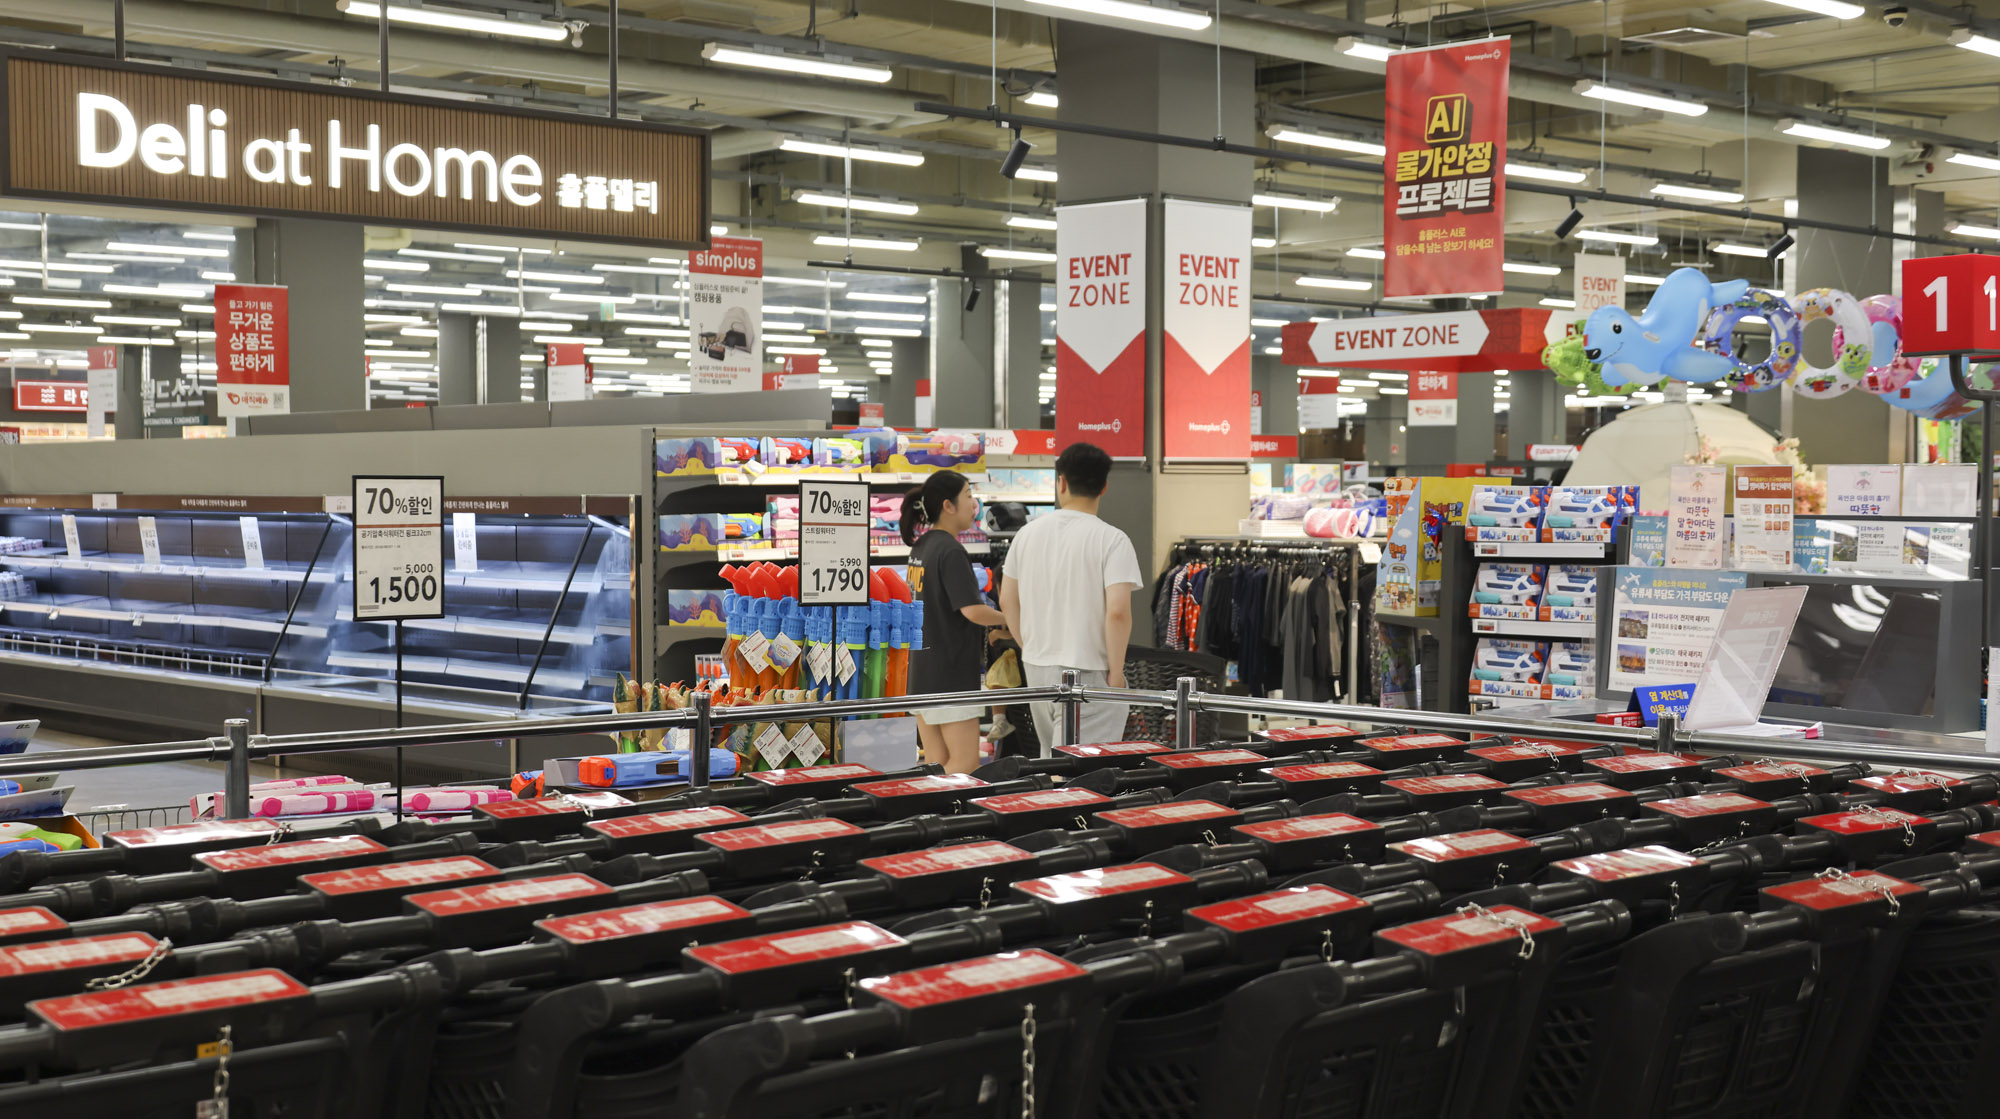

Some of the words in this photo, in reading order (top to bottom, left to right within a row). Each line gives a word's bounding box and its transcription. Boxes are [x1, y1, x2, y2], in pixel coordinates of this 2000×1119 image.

[1465, 53, 1492, 61] Homeplus
[1428, 99, 1461, 134] AI
[78, 92, 228, 178] Deli
[243, 129, 311, 186] at
[328, 119, 543, 206] Home
[1395, 141, 1493, 182] 물가안정
[1396, 177, 1492, 215] 프로젝트
[1419, 229, 1448, 241] 홈플러스
[1427, 242, 1441, 254] 남는
[1443, 240, 1467, 252] 장보기
[1468, 238, 1494, 250] 하세요!
[696, 250, 756, 272] simplus
[1069, 253, 1132, 279] EVENT
[1179, 253, 1240, 279] EVENT
[1582, 276, 1618, 293] EVENT
[1068, 282, 1130, 308] ZONE
[1179, 282, 1239, 308] ZONE
[1582, 293, 1617, 309] ZONE
[1983, 275, 1997, 331] 1
[245, 301, 258, 310] 가기
[1922, 276, 1948, 332] 1
[229, 312, 274, 331] 무거운
[229, 332, 275, 351] 상품도
[1335, 328, 1397, 351] EVENT
[1402, 324, 1459, 347] ZONE
[103, 349, 114, 368] 12
[229, 353, 275, 373] 편하게
[550, 347, 558, 366] 3
[785, 357, 793, 373] 4
[1301, 379, 1310, 394] 7
[1418, 375, 1448, 391] 편하게
[1252, 393, 1259, 406] 8
[1078, 421, 1111, 432] Homeplus
[1188, 422, 1221, 433] Homeplus
[985, 436, 1004, 447] ONE
[365, 487, 432, 515] 70%할인
[809, 490, 862, 516] 70%할인
[1850, 504, 1880, 514] 따뜻한
[1686, 506, 1710, 517] 따뜻한
[1677, 518, 1685, 528] 말
[1686, 518, 1716, 530] 한마디는
[1581, 534, 1604, 542] BLASTER
[1676, 530, 1698, 541] 마음의
[405, 563, 434, 575] 5,000
[840, 557, 861, 568] 5,990
[812, 568, 864, 592] 1,790
[369, 575, 437, 605] 1,500
[1631, 587, 1652, 599] 유류세
[1654, 589, 1675, 600] 부담도
[1676, 589, 1691, 601] 가격
[1691, 591, 1713, 602] 부담도
[1713, 592, 1729, 603] 다운
[1508, 611, 1529, 619] BLASTER
[1511, 689, 1533, 697] BLASTER
[1648, 691, 1659, 702] 옆
